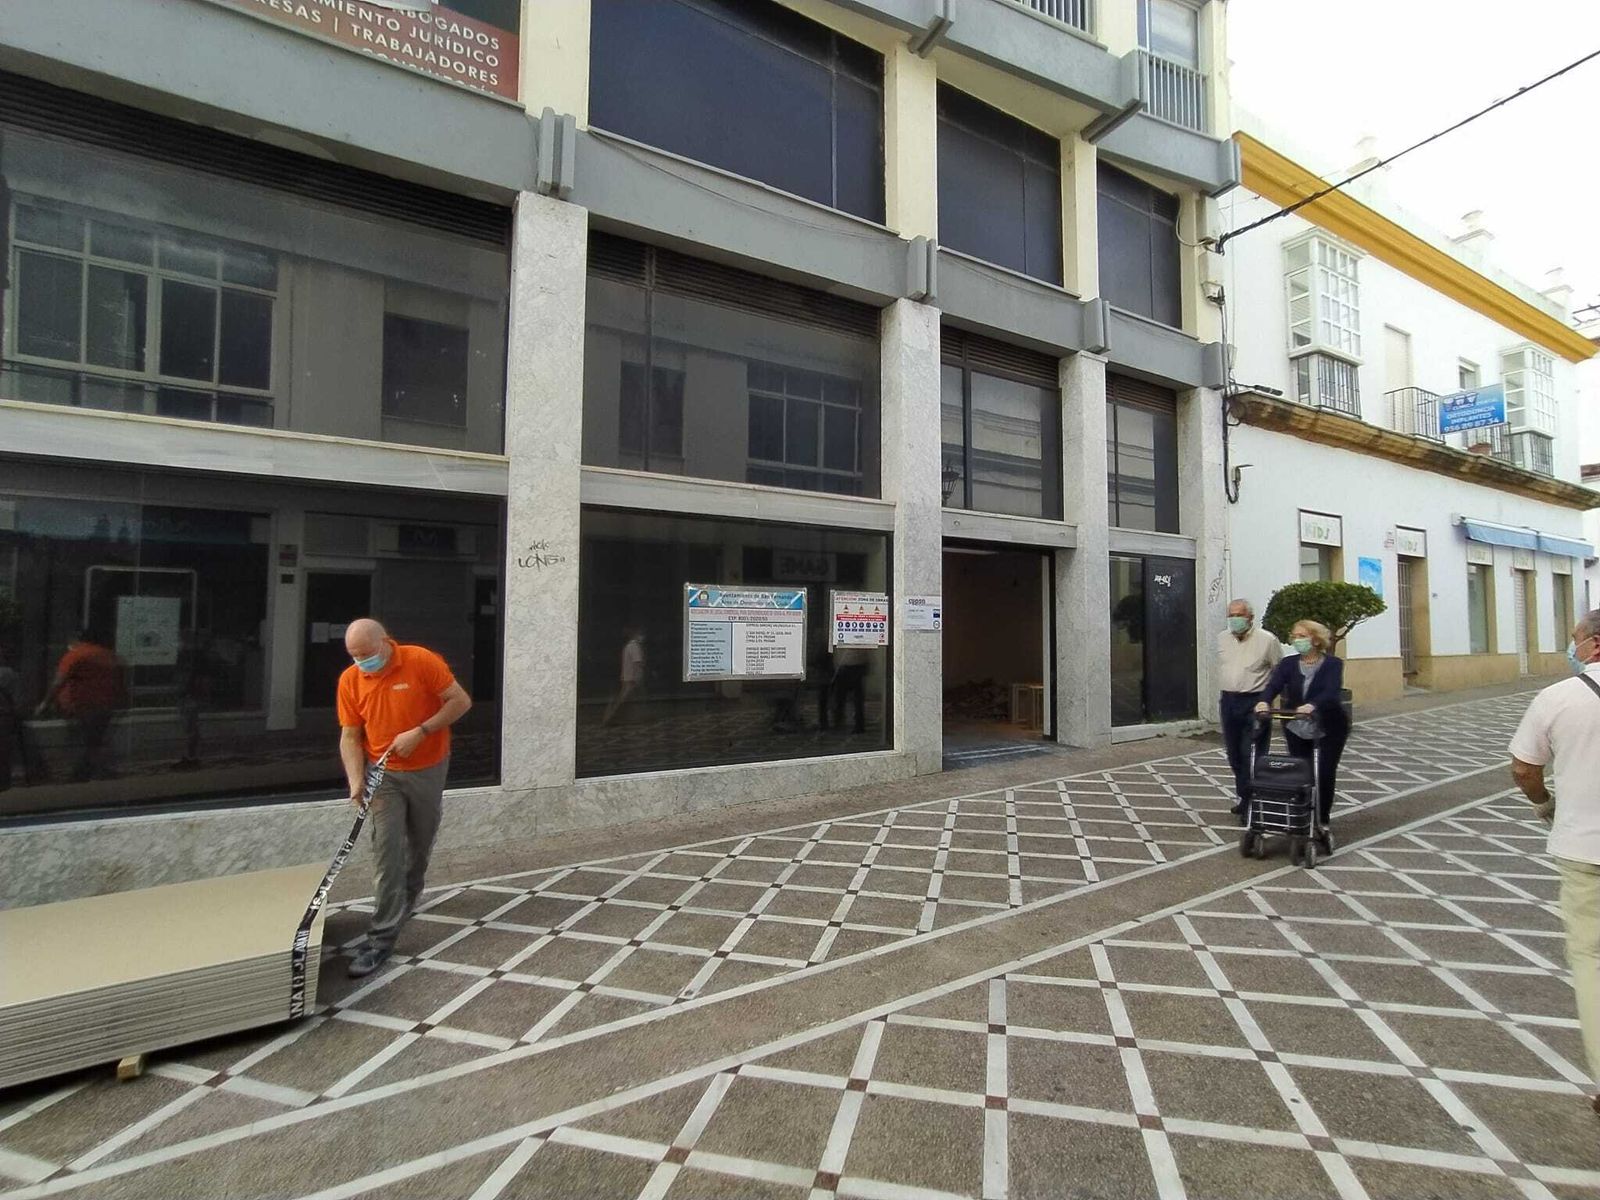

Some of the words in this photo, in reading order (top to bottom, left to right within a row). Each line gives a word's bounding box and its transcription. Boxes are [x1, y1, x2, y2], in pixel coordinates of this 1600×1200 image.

[313, 0, 401, 31] MIENTO
[409, 26, 499, 67] JURÍDICO
[351, 23, 498, 85] TRABAJADORES
